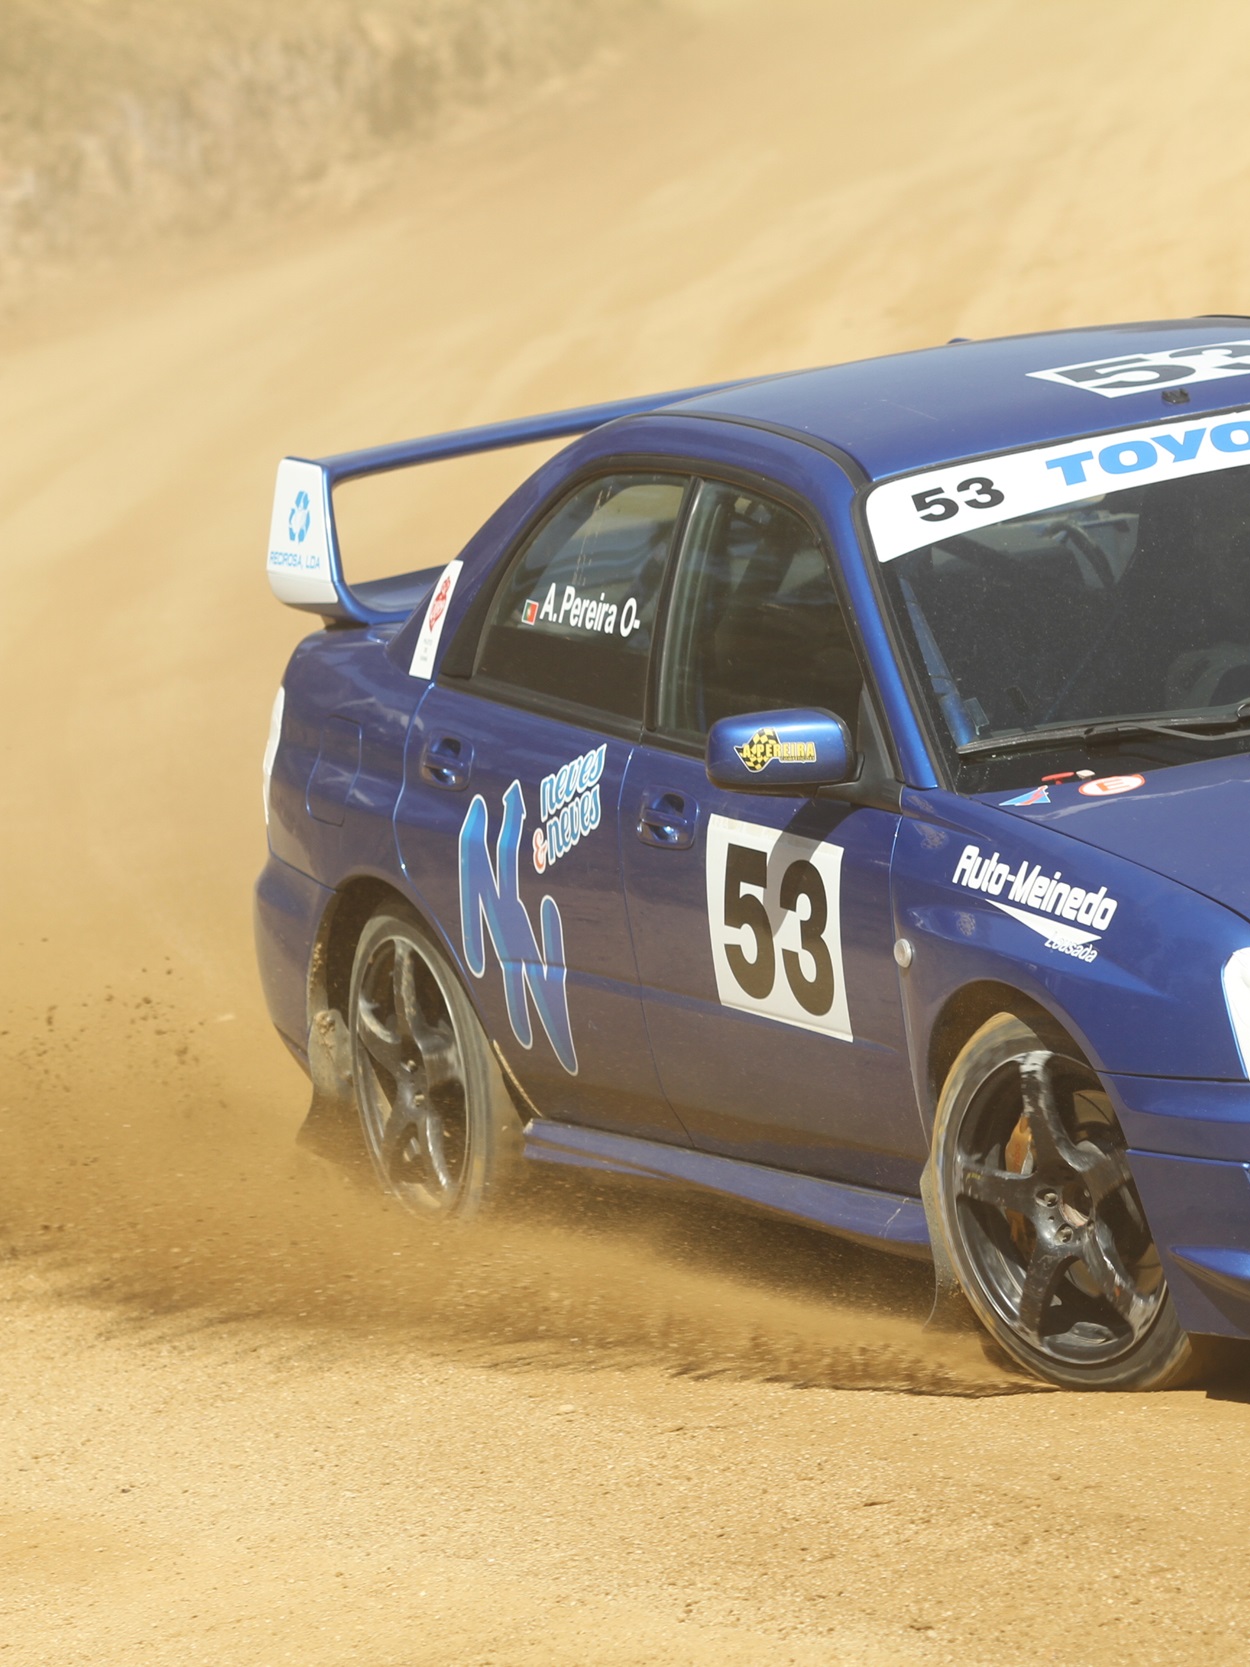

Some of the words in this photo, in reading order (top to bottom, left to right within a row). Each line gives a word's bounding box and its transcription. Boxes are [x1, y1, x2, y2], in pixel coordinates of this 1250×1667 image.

[911, 476, 1005, 523] 53
[541, 743, 607, 823] neves
[546, 783, 601, 866] neves
[952, 844, 1118, 931] Auto-Meinedo
[723, 843, 835, 1016] 53
